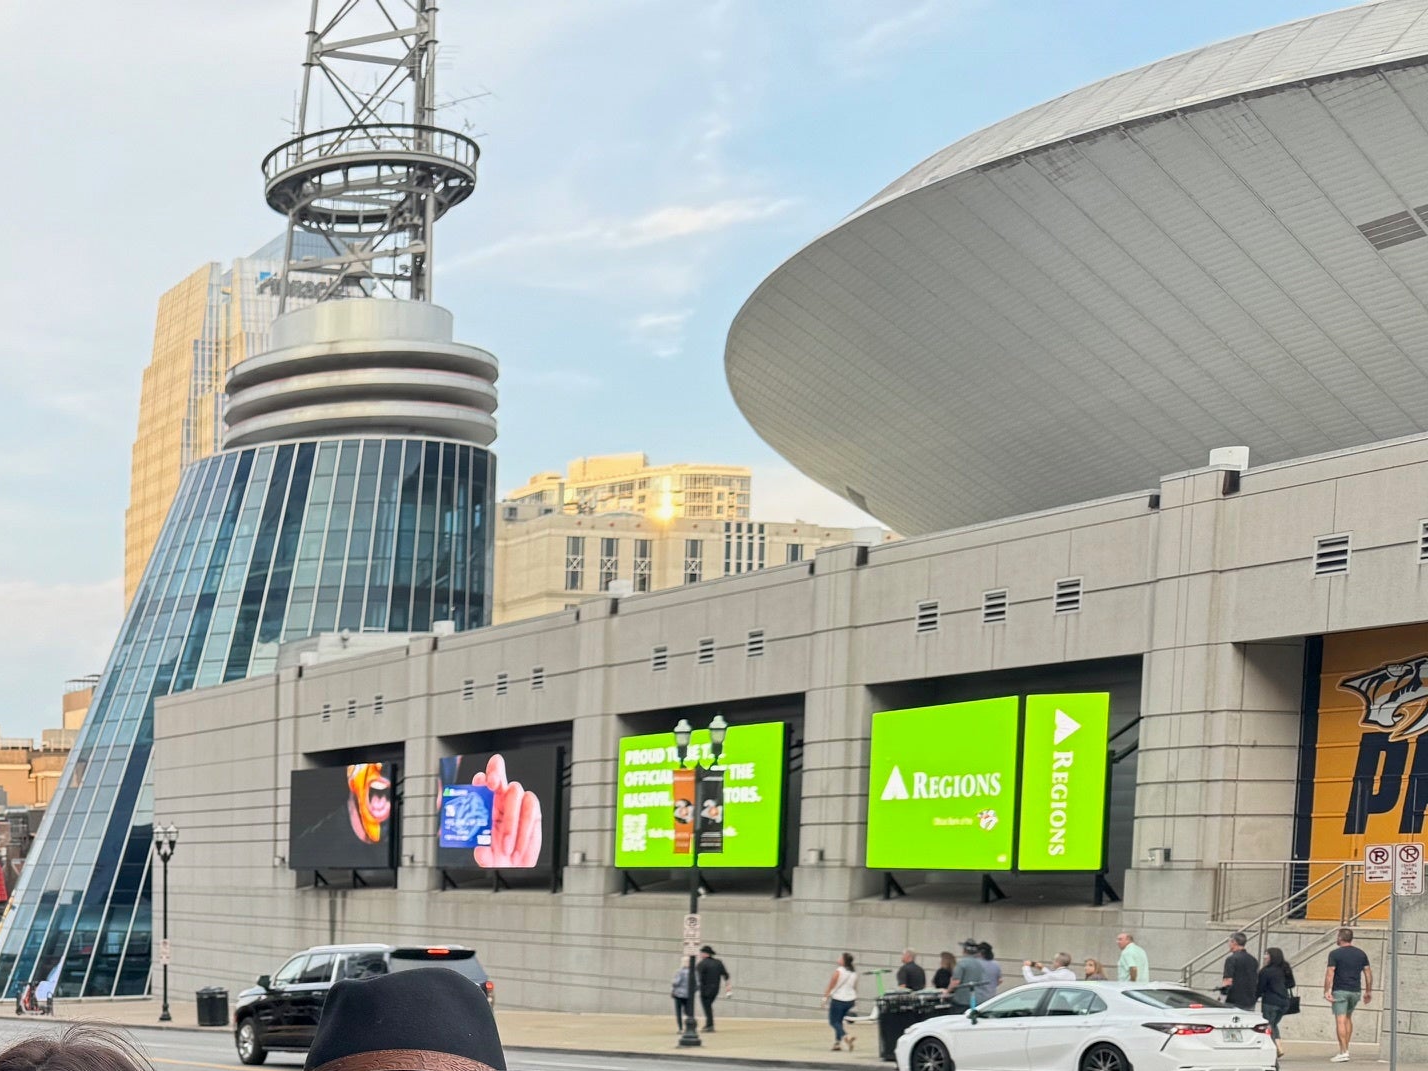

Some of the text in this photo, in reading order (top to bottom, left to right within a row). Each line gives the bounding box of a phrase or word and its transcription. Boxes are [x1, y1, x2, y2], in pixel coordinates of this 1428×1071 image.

[624, 748, 665, 766] PROUD
[729, 763, 756, 781] THE
[912, 772, 1002, 799] REGIONS
[1047, 751, 1074, 856] REGIONS
